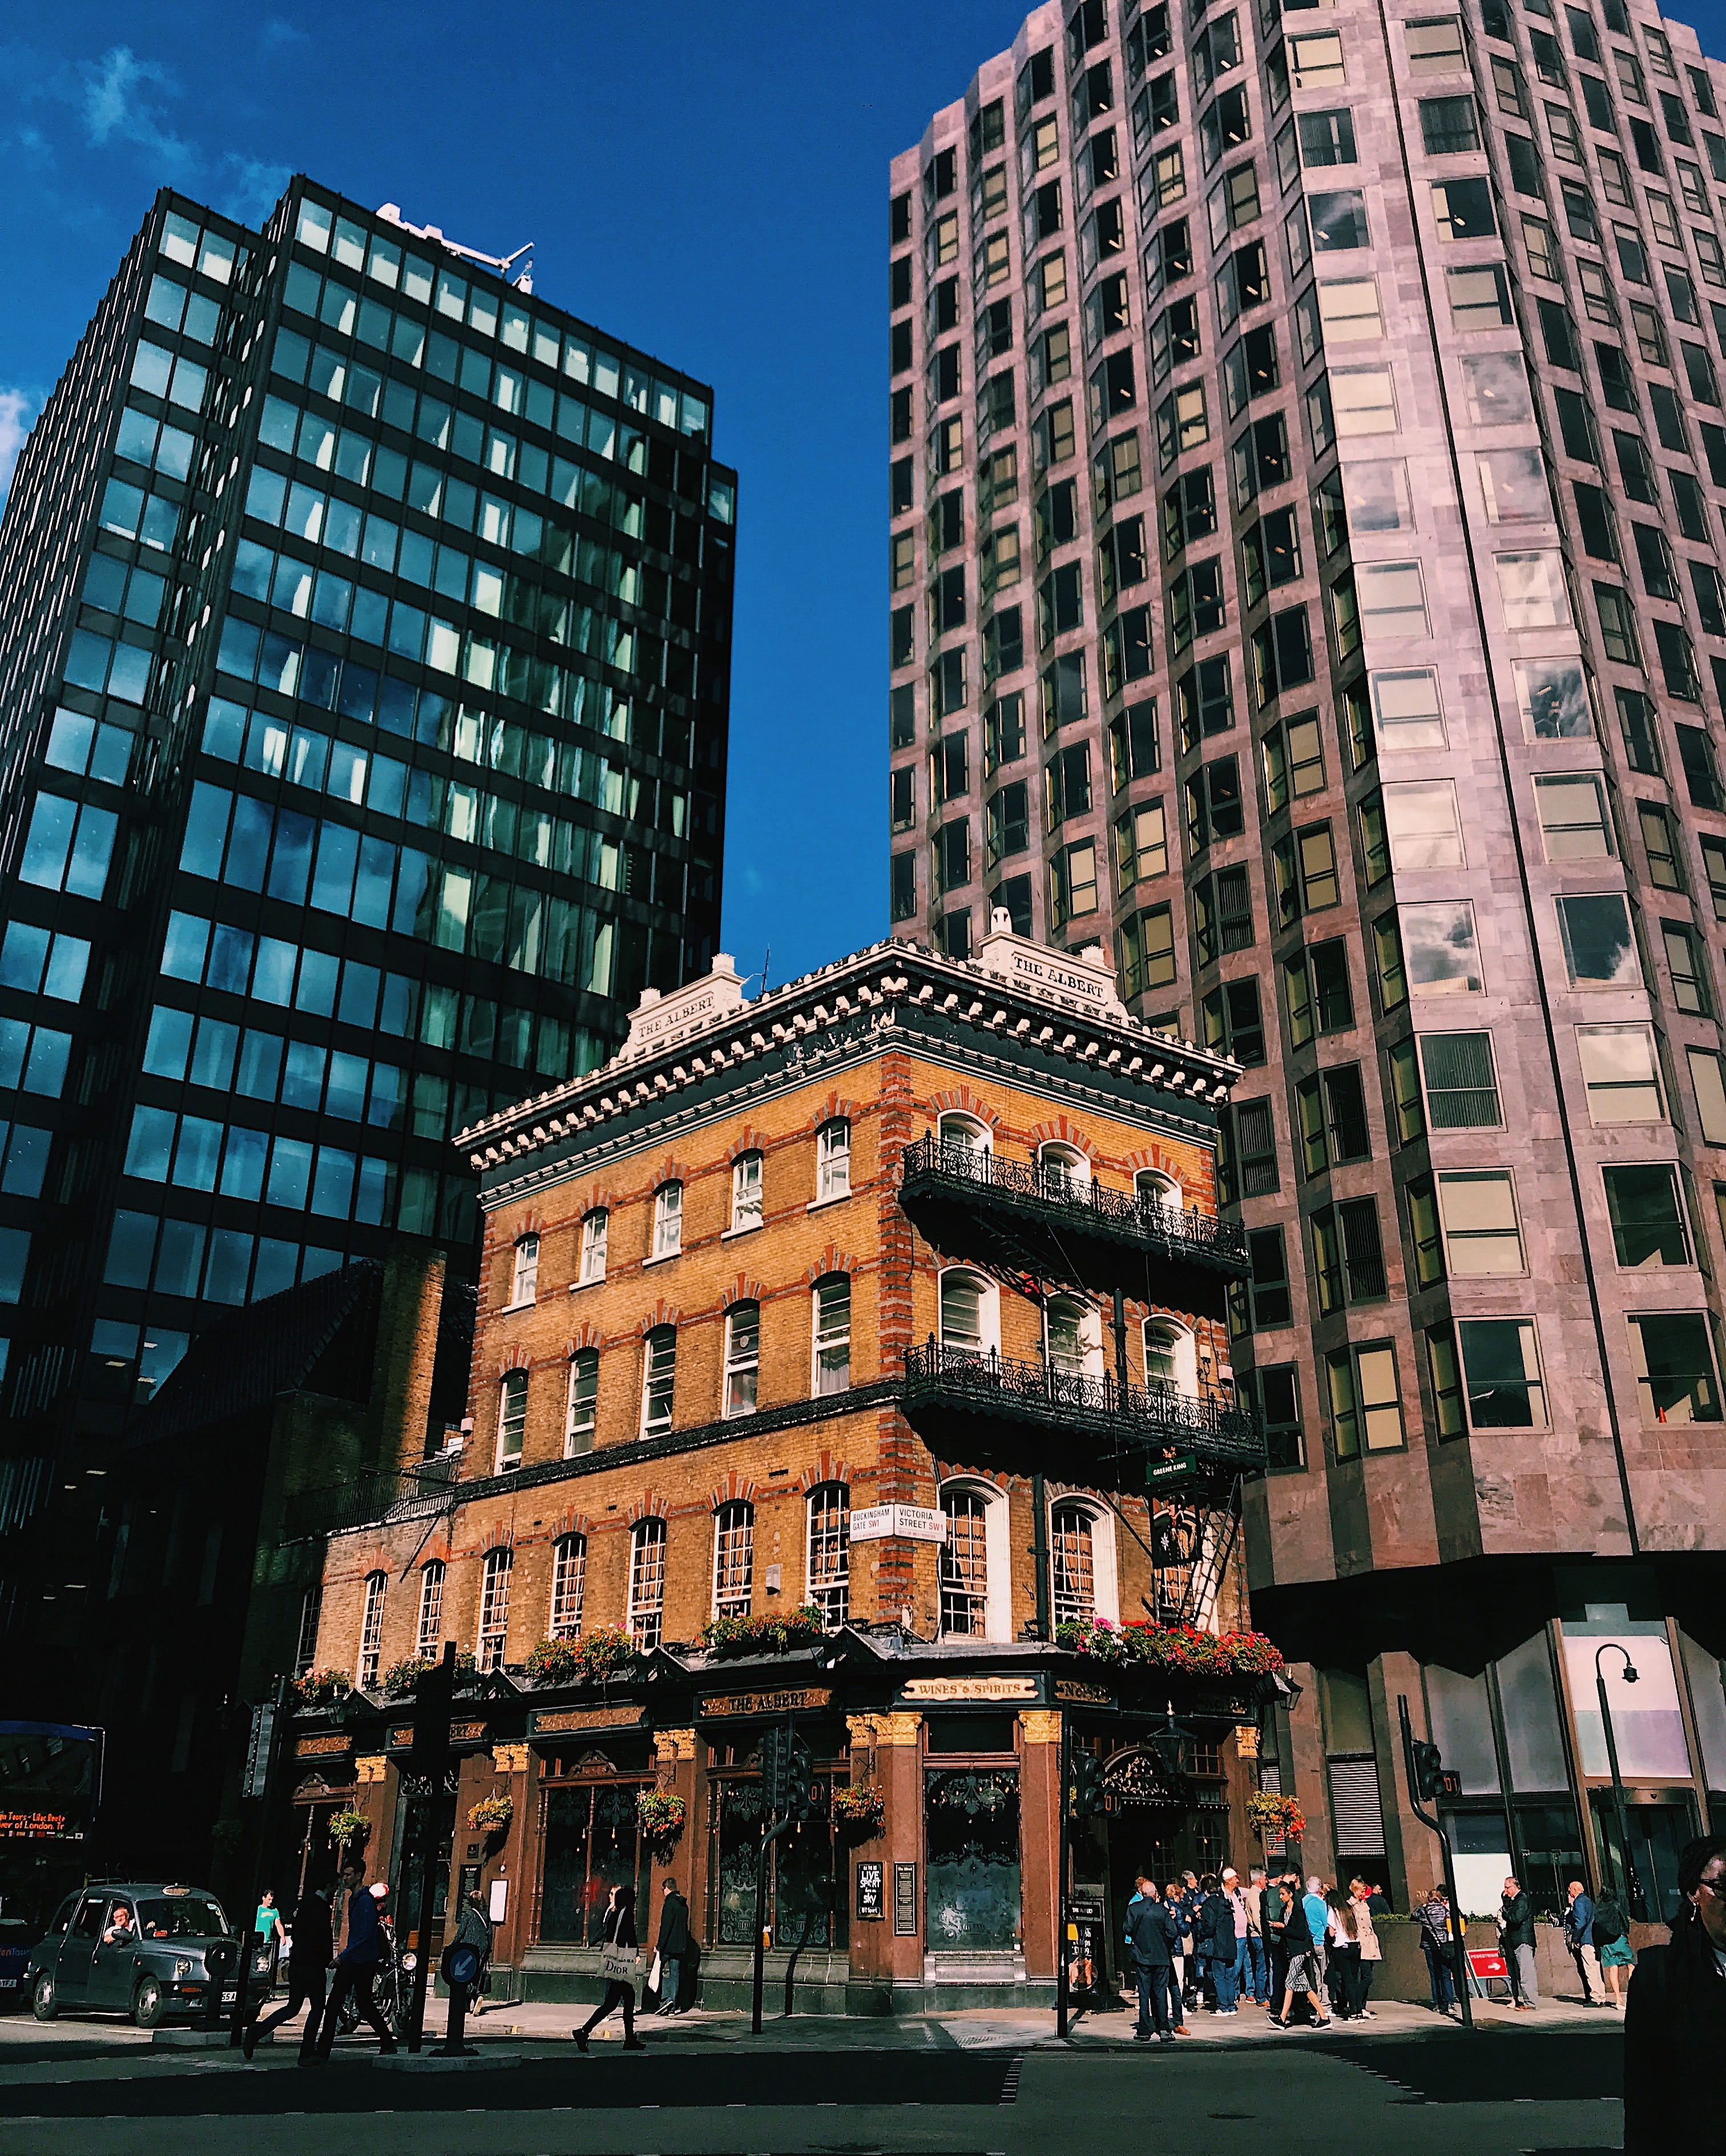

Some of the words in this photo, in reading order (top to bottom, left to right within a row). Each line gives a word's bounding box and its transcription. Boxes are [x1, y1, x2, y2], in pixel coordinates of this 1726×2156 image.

[1014, 956, 1042, 976] THE
[1048, 969, 1103, 998] ALBERT
[639, 1019, 662, 1038] THE
[665, 996, 713, 1027] ALBERT
[1153, 1465, 1172, 1476] GREENE
[1173, 1462, 1187, 1471] KING
[853, 1508, 889, 1521] BUCKINGHAM
[900, 1508, 933, 1521] VICTORIA
[853, 1521, 866, 1531] GATE
[869, 1519, 879, 1528] SW1
[900, 1518, 927, 1529] STREET
[919, 1685, 957, 1694] WINES
[974, 1683, 1021, 1694] SPIRITS
[729, 1696, 753, 1711] THE
[757, 1691, 807, 1710] ALBERT
[9, 1812, 27, 1821] Tours
[47, 1814, 66, 1822] Route
[15, 1820, 22, 1829] of
[862, 1871, 880, 1880] LIVE
